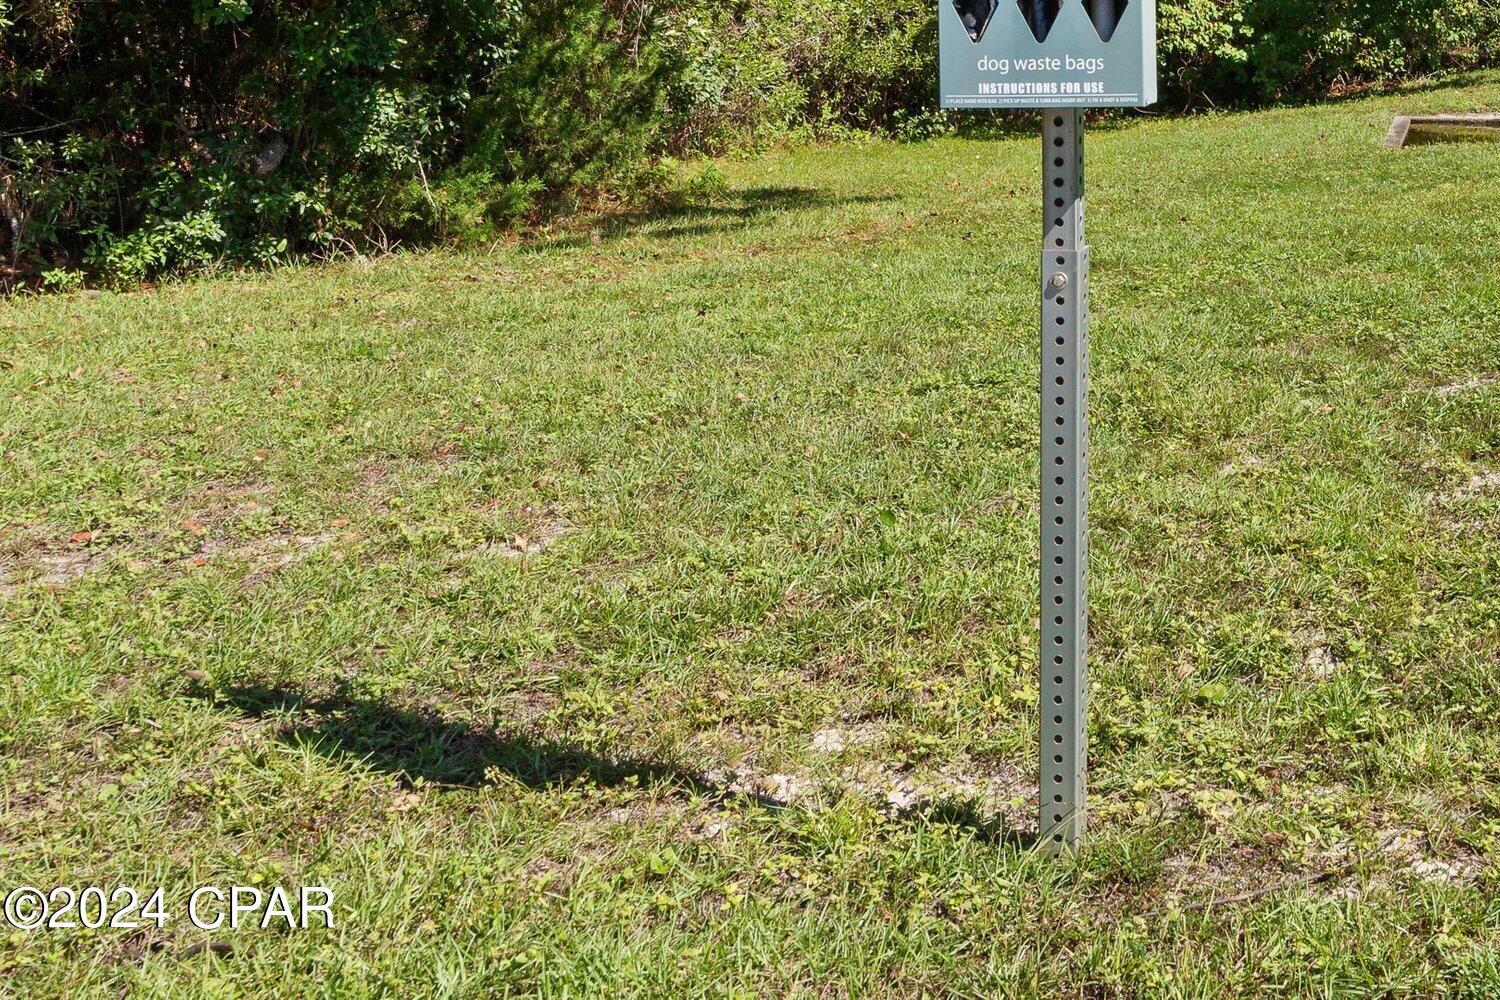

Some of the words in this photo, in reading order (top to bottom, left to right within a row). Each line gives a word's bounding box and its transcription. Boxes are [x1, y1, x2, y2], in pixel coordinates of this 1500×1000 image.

[977, 55, 1009, 74] dog
[1014, 57, 1061, 71] waste
[1065, 54, 1105, 74] bags
[978, 82, 1057, 94] INSTRUCTIONS
[1060, 81, 1081, 94] FOR
[1083, 81, 1105, 94] USE
